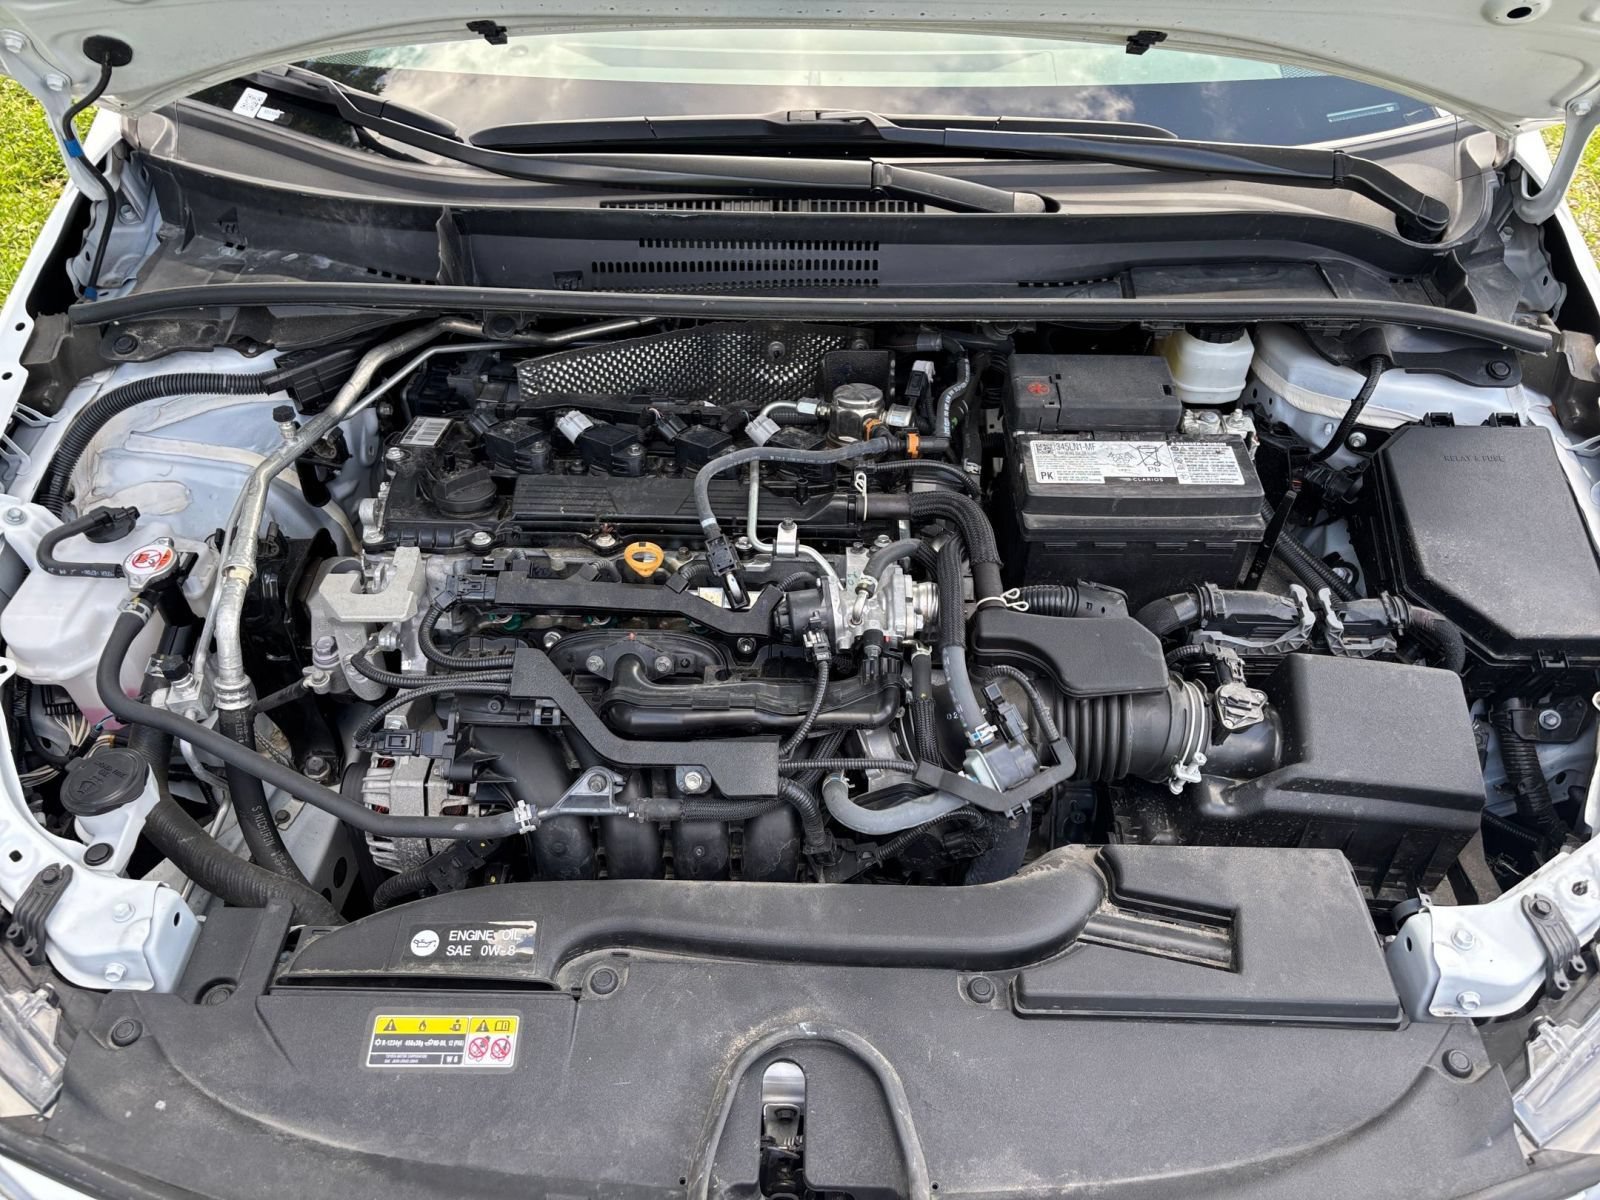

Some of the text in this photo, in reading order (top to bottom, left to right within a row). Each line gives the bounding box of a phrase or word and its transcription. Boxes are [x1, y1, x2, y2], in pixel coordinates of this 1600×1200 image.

[1040, 471, 1054, 480] PK
[449, 929, 521, 941] ENGINE OIL
[446, 945, 472, 956] SAE
